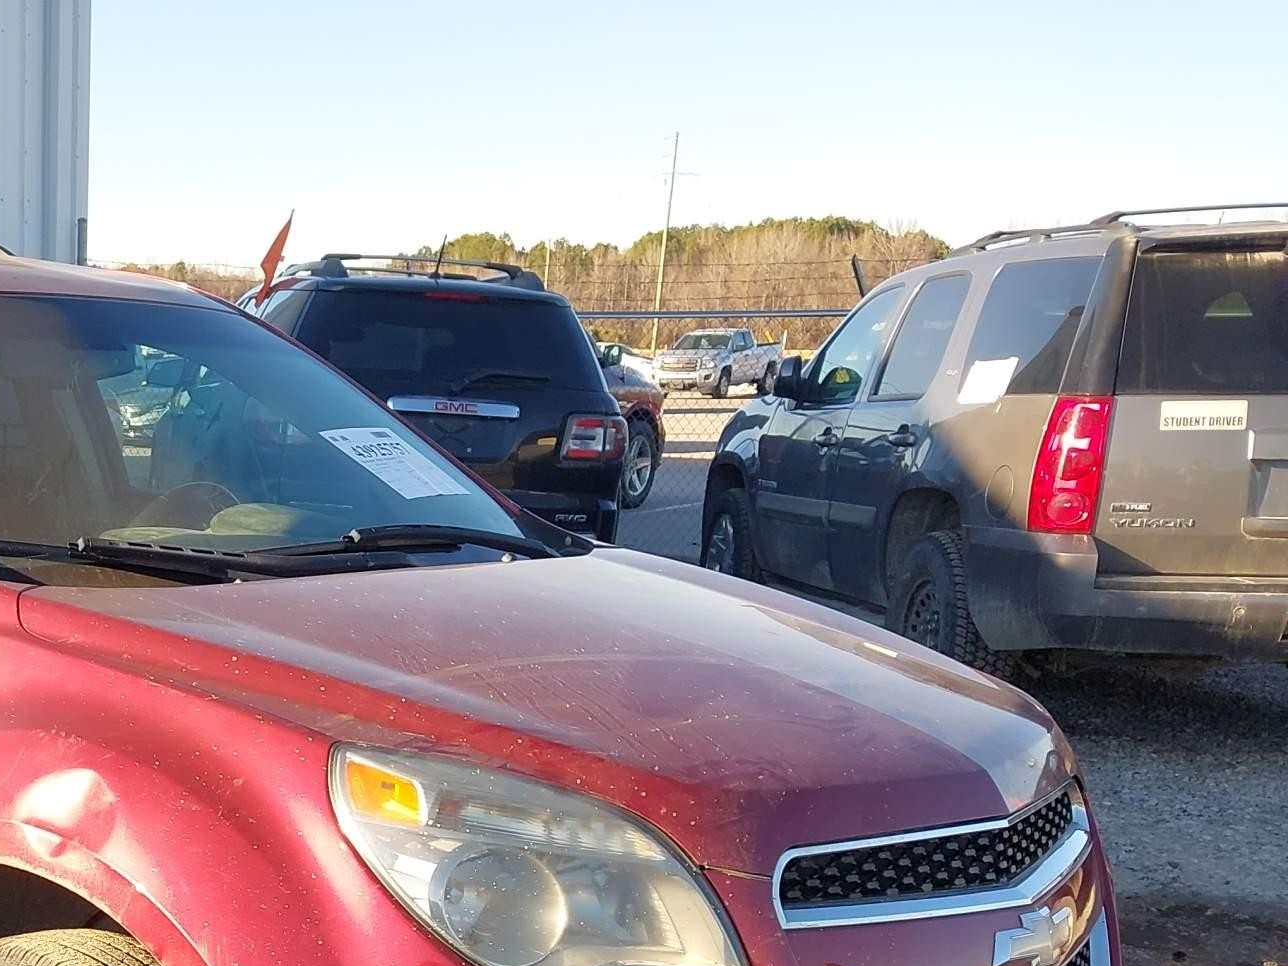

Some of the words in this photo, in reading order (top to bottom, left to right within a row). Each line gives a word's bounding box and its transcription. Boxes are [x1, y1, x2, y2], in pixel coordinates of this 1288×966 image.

[434, 401, 478, 413] GMC
[1163, 416, 1206, 427] STUDENT
[1208, 416, 1244, 426] DRIVER
[351, 442, 410, 458] 43925757
[1109, 518, 1196, 528] YUKON
